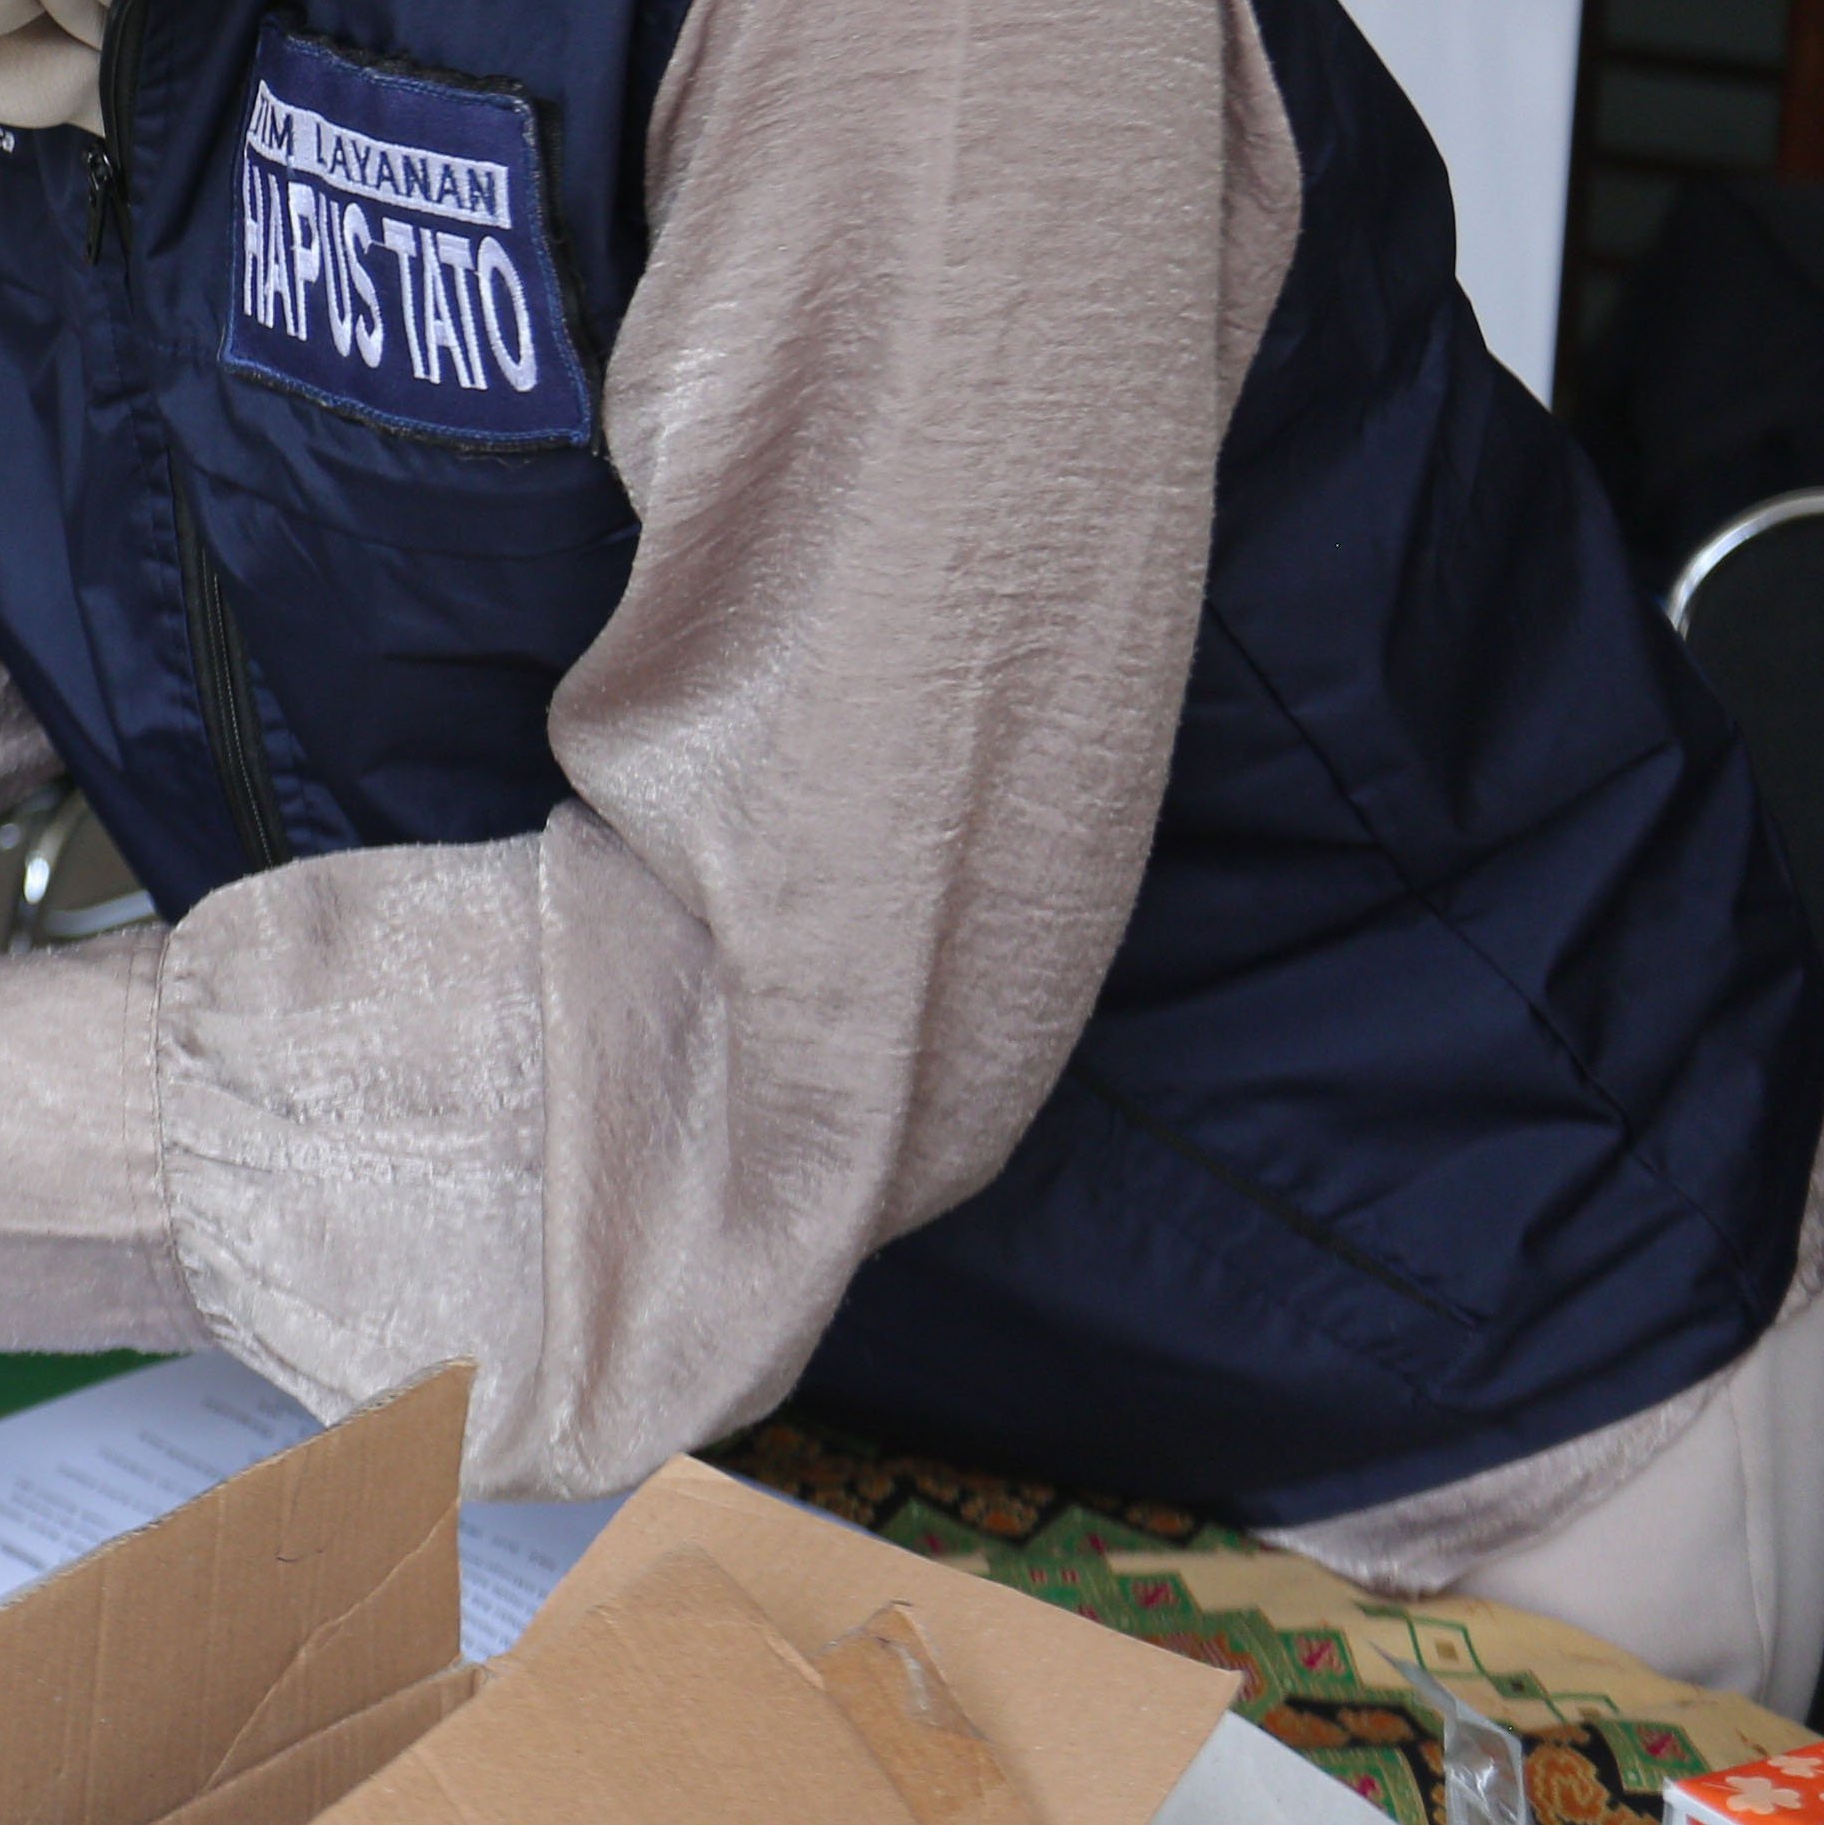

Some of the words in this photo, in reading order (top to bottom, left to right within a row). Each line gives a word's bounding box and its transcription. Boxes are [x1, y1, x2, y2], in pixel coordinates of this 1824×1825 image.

[313, 123, 498, 220] LAYANAN
[242, 153, 385, 369] HAPUS
[381, 215, 539, 393] TATO
